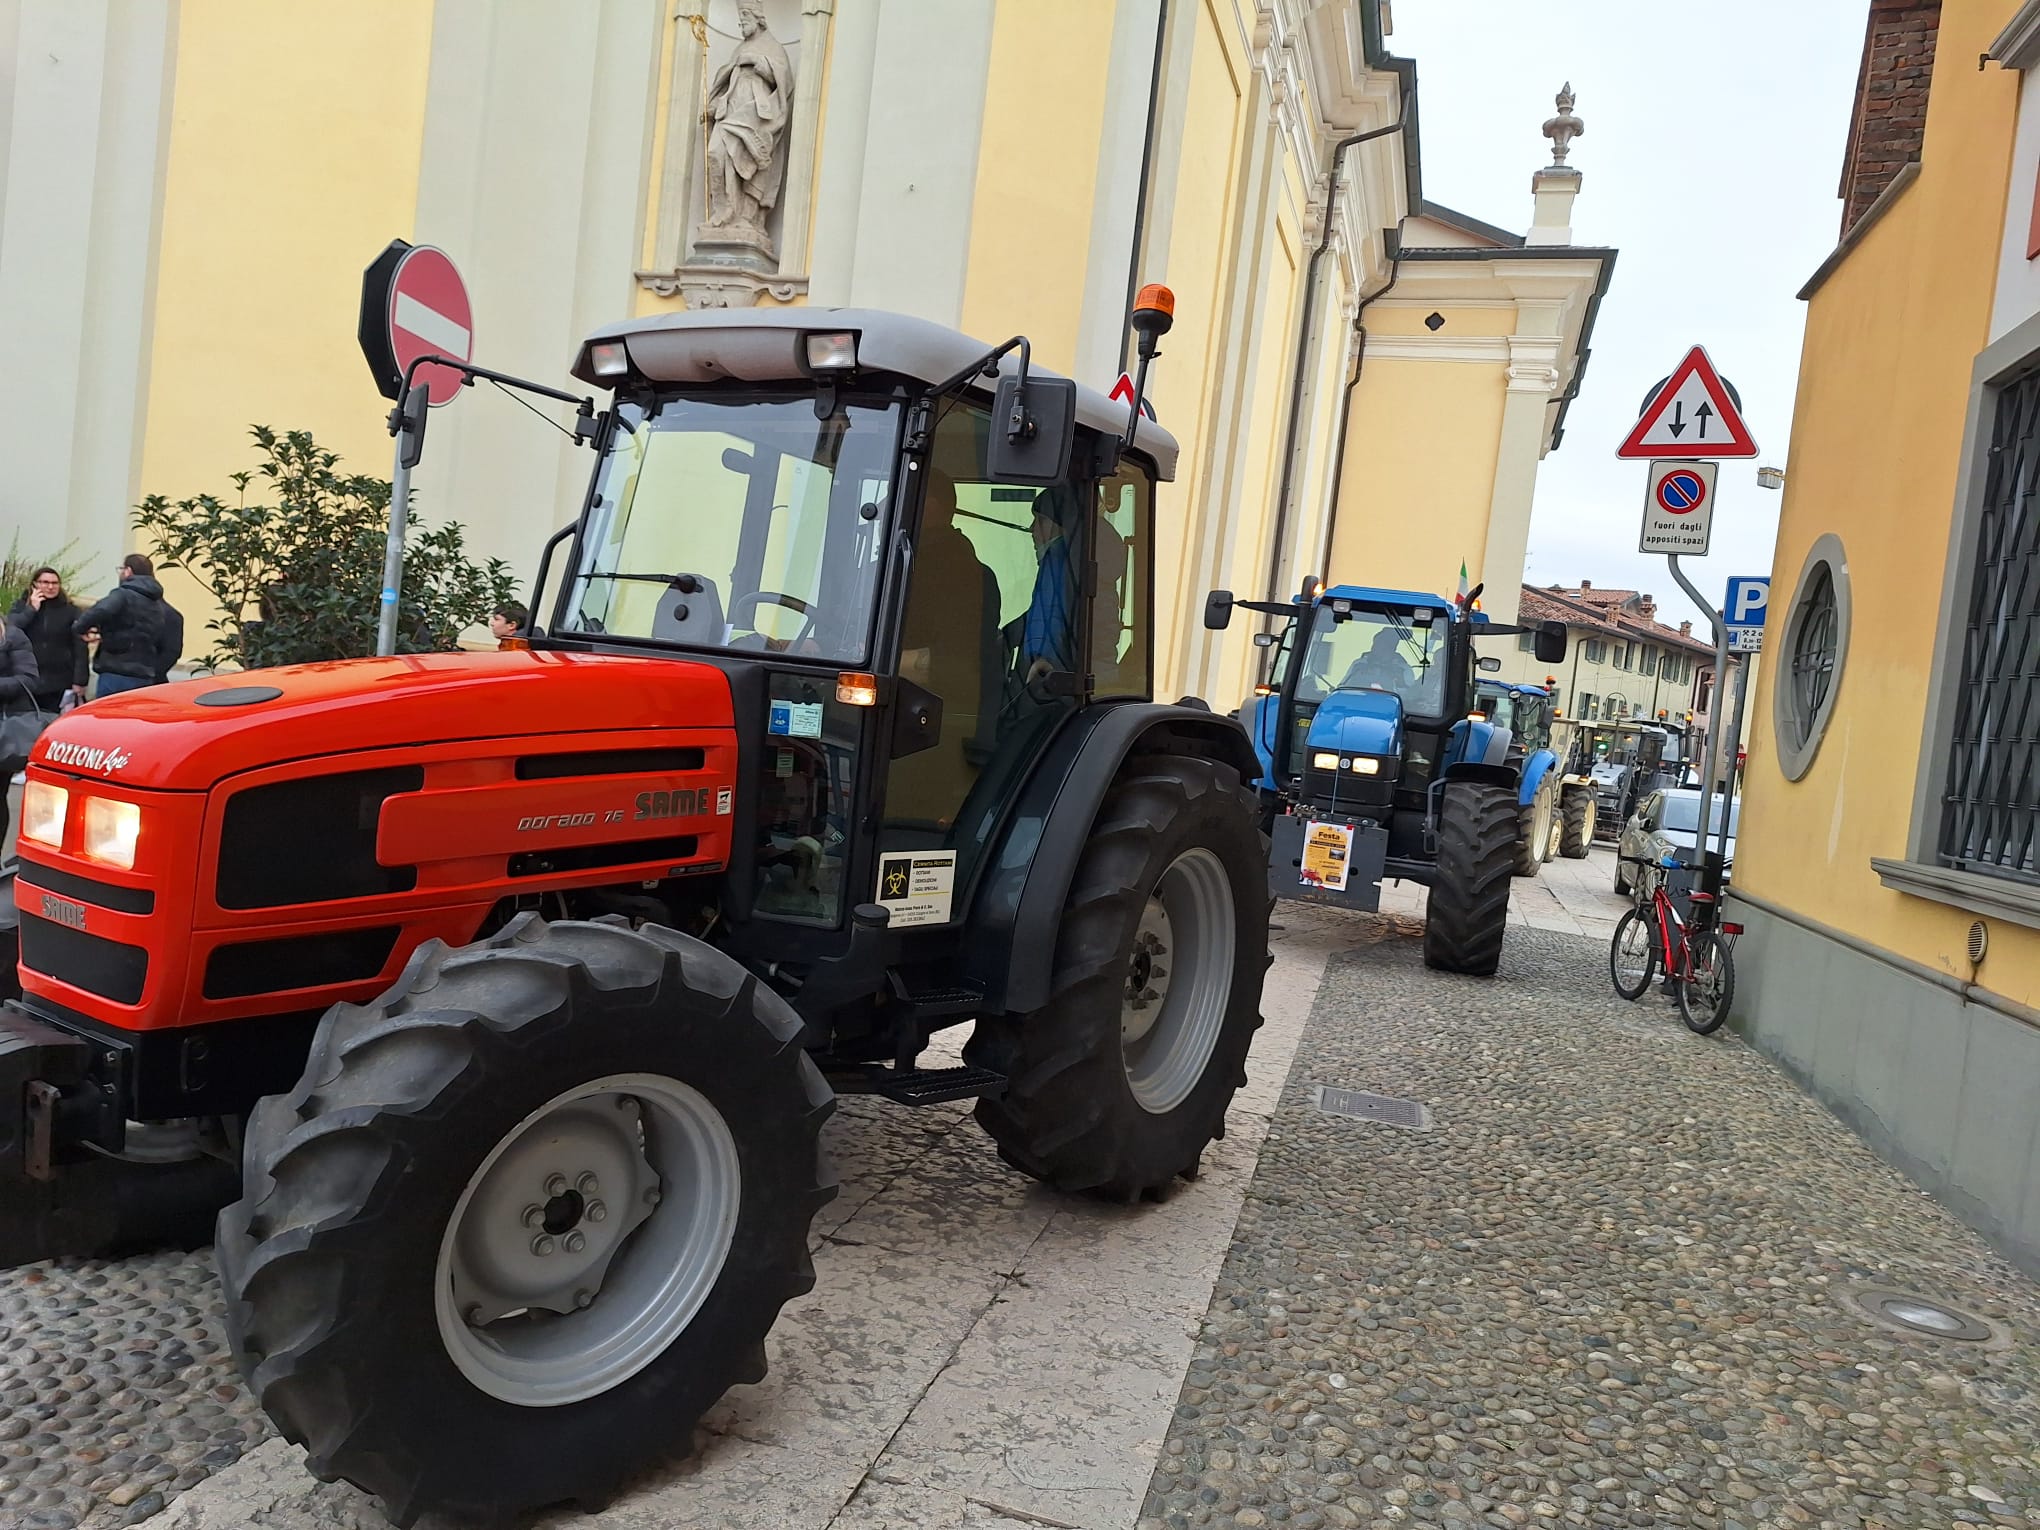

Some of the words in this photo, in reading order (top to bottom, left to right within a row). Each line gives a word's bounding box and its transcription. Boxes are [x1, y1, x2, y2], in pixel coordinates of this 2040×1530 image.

[1646, 535, 1681, 545] appositi
[1682, 536, 1705, 546] spazi
[1654, 520, 1676, 530] fuori
[1680, 522, 1703, 533] dagli
[1734, 581, 1770, 621] P
[45, 740, 105, 770] ROZZONI
[633, 787, 710, 821] SAME
[1318, 831, 1341, 841] Festa
[41, 894, 87, 930] SAME
